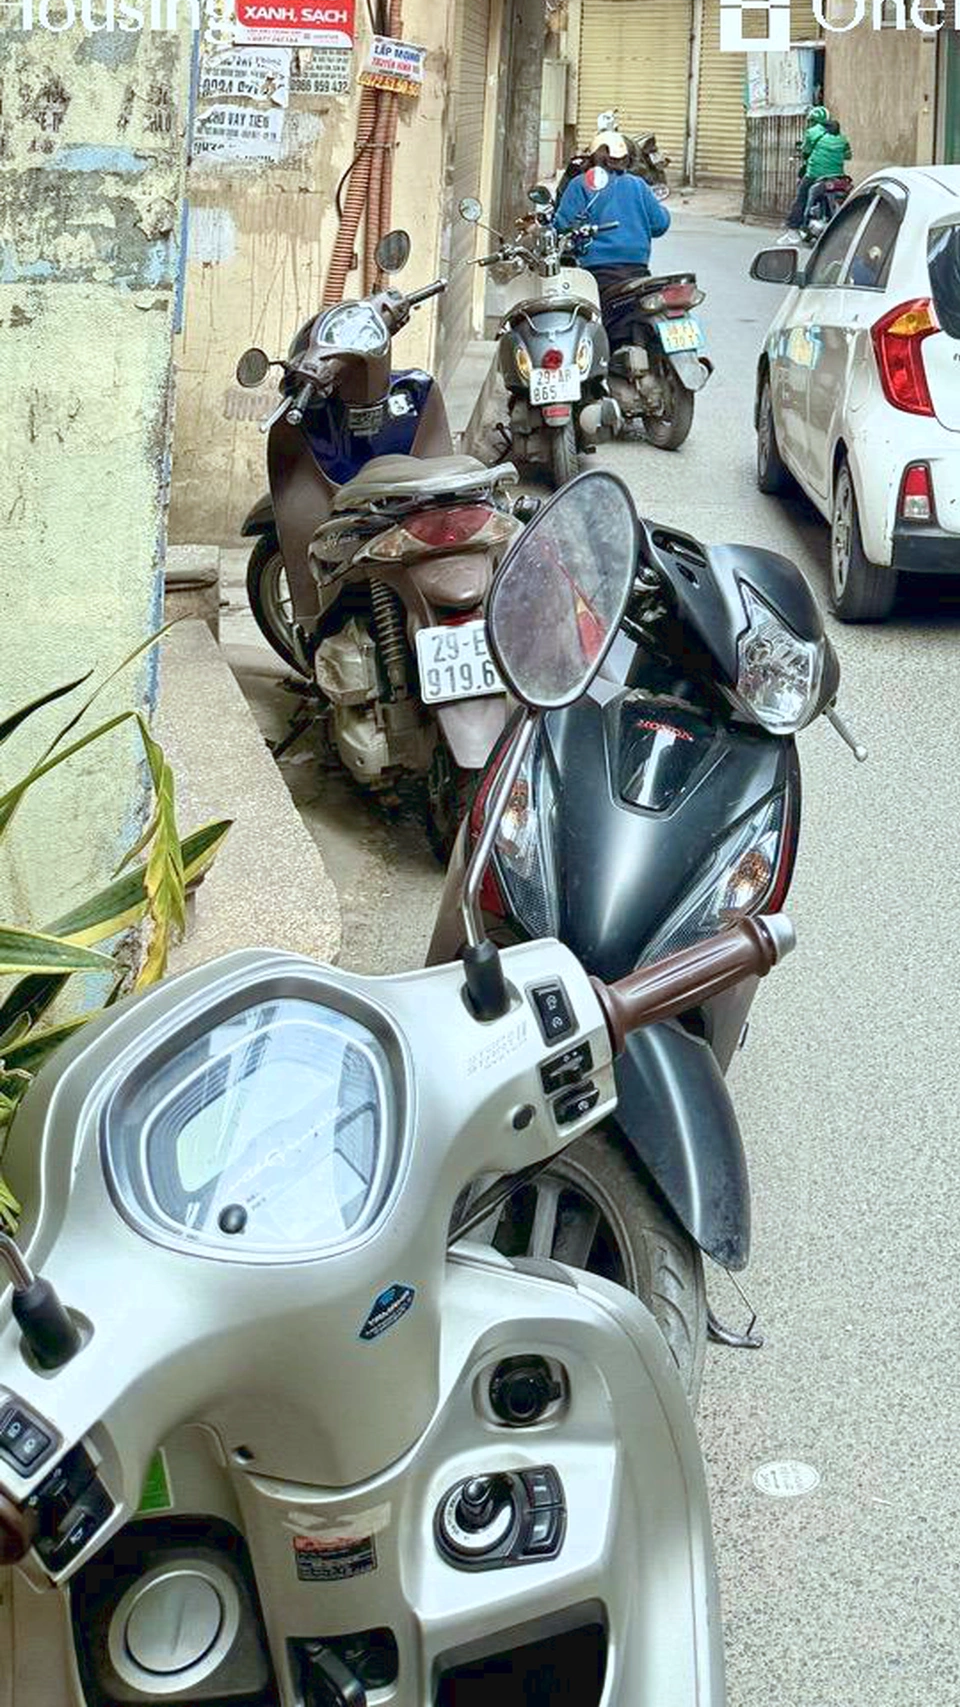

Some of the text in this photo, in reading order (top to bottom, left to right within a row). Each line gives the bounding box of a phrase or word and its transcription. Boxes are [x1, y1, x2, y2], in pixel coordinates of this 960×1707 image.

[301, 8, 347, 24] SẠCH
[431, 628, 486, 662] 29-E
[427, 659, 495, 696] 919.6
